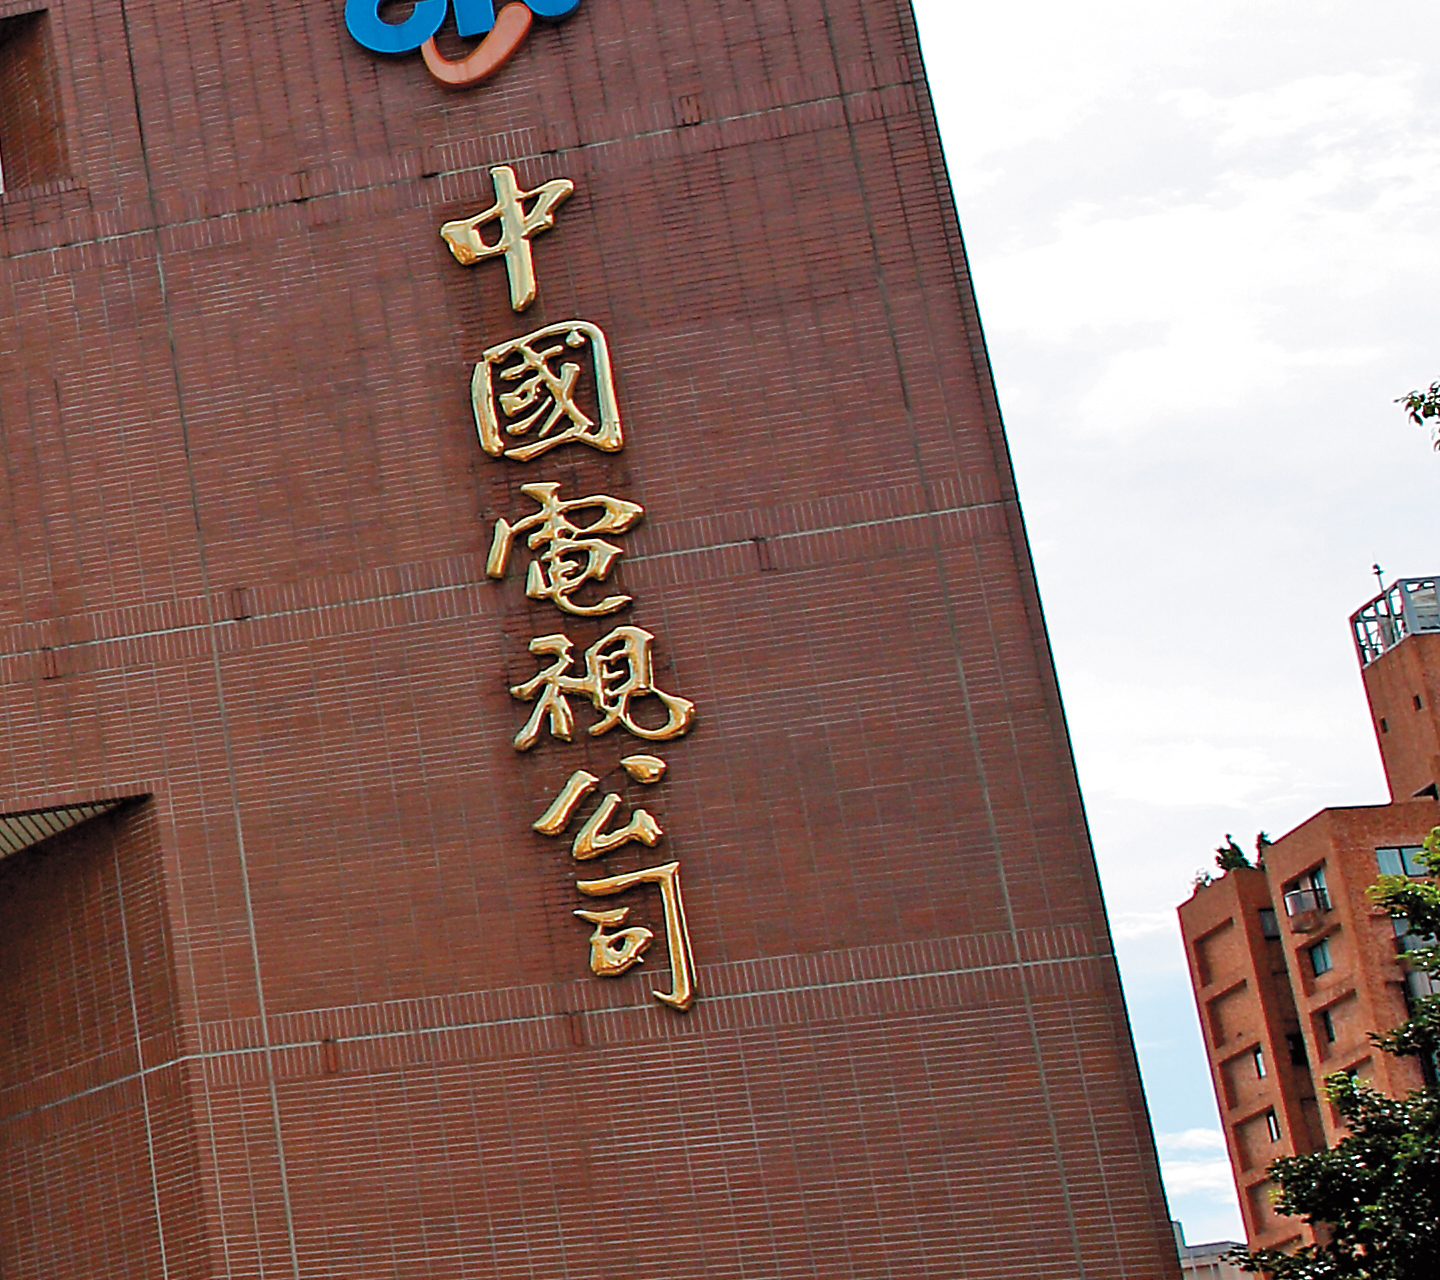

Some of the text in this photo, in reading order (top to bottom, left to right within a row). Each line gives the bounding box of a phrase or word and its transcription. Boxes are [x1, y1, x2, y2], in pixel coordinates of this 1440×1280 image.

[439, 165, 698, 1012] 中國電視公司
